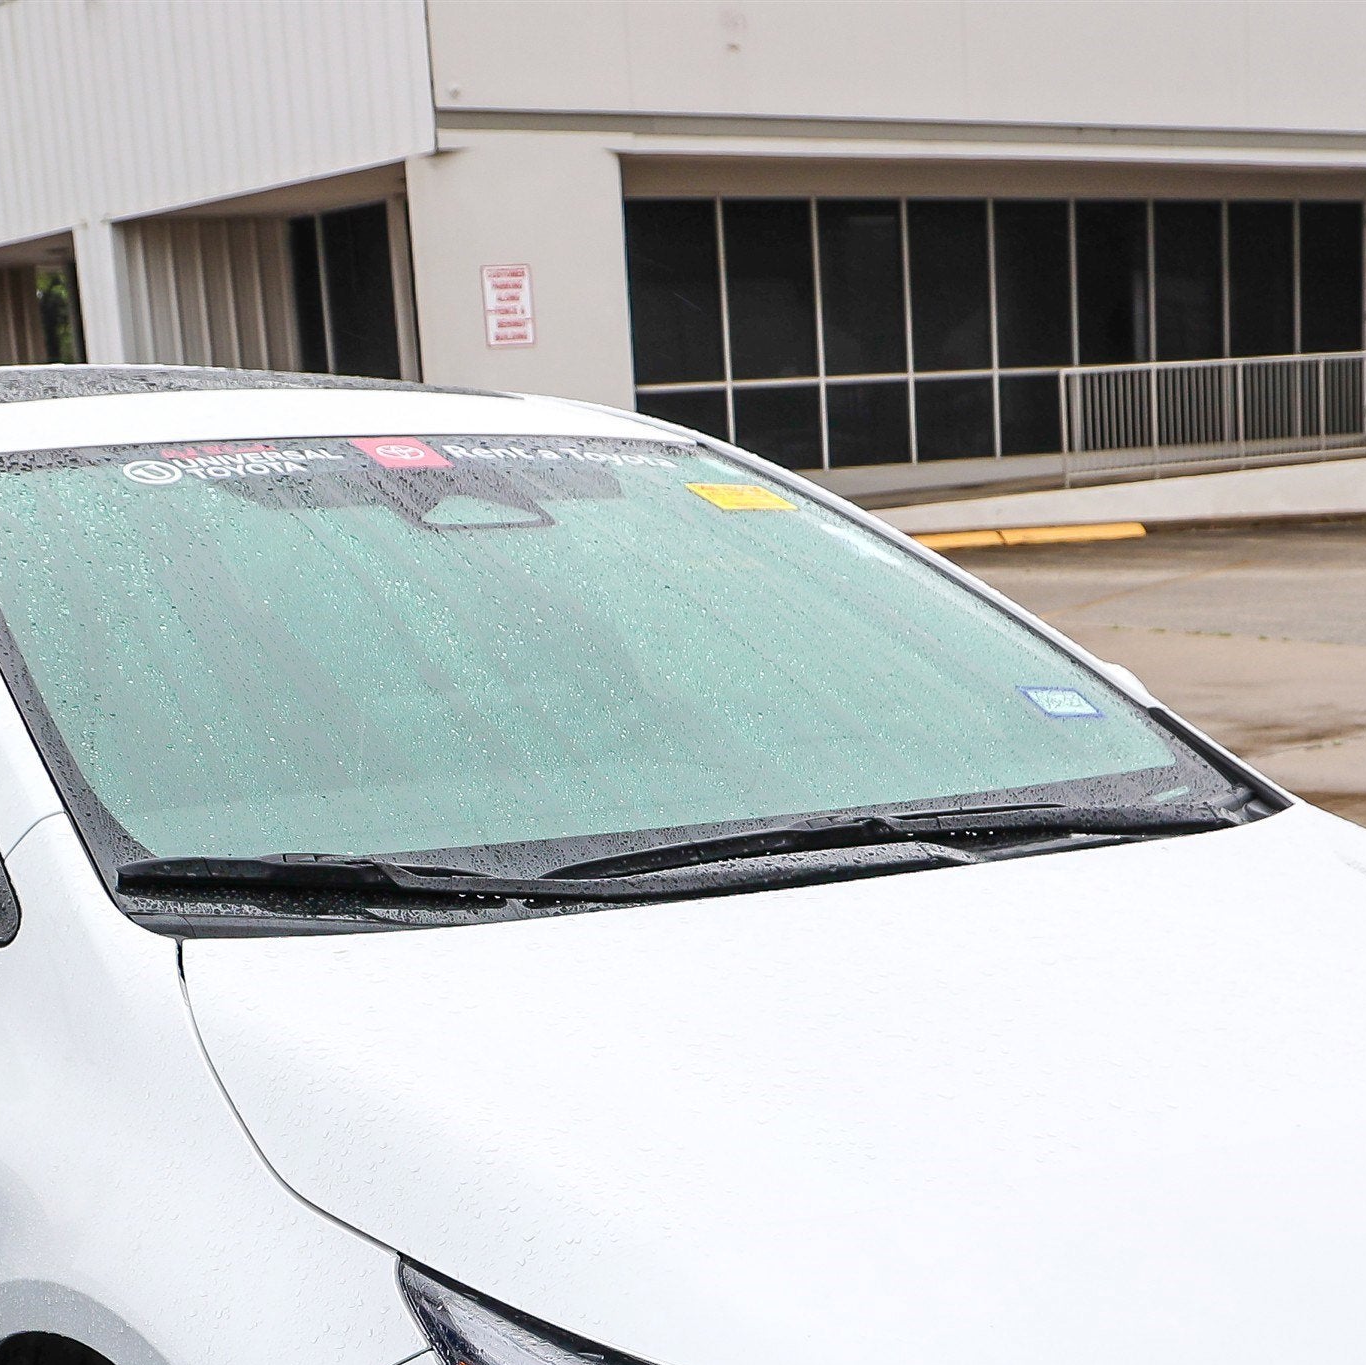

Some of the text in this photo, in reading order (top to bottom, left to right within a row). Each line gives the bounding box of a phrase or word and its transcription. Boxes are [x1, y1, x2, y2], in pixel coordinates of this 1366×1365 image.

[170, 448, 344, 469] UNIVERSAL
[442, 444, 535, 460] Rent
[184, 461, 308, 480] TOYOTA
